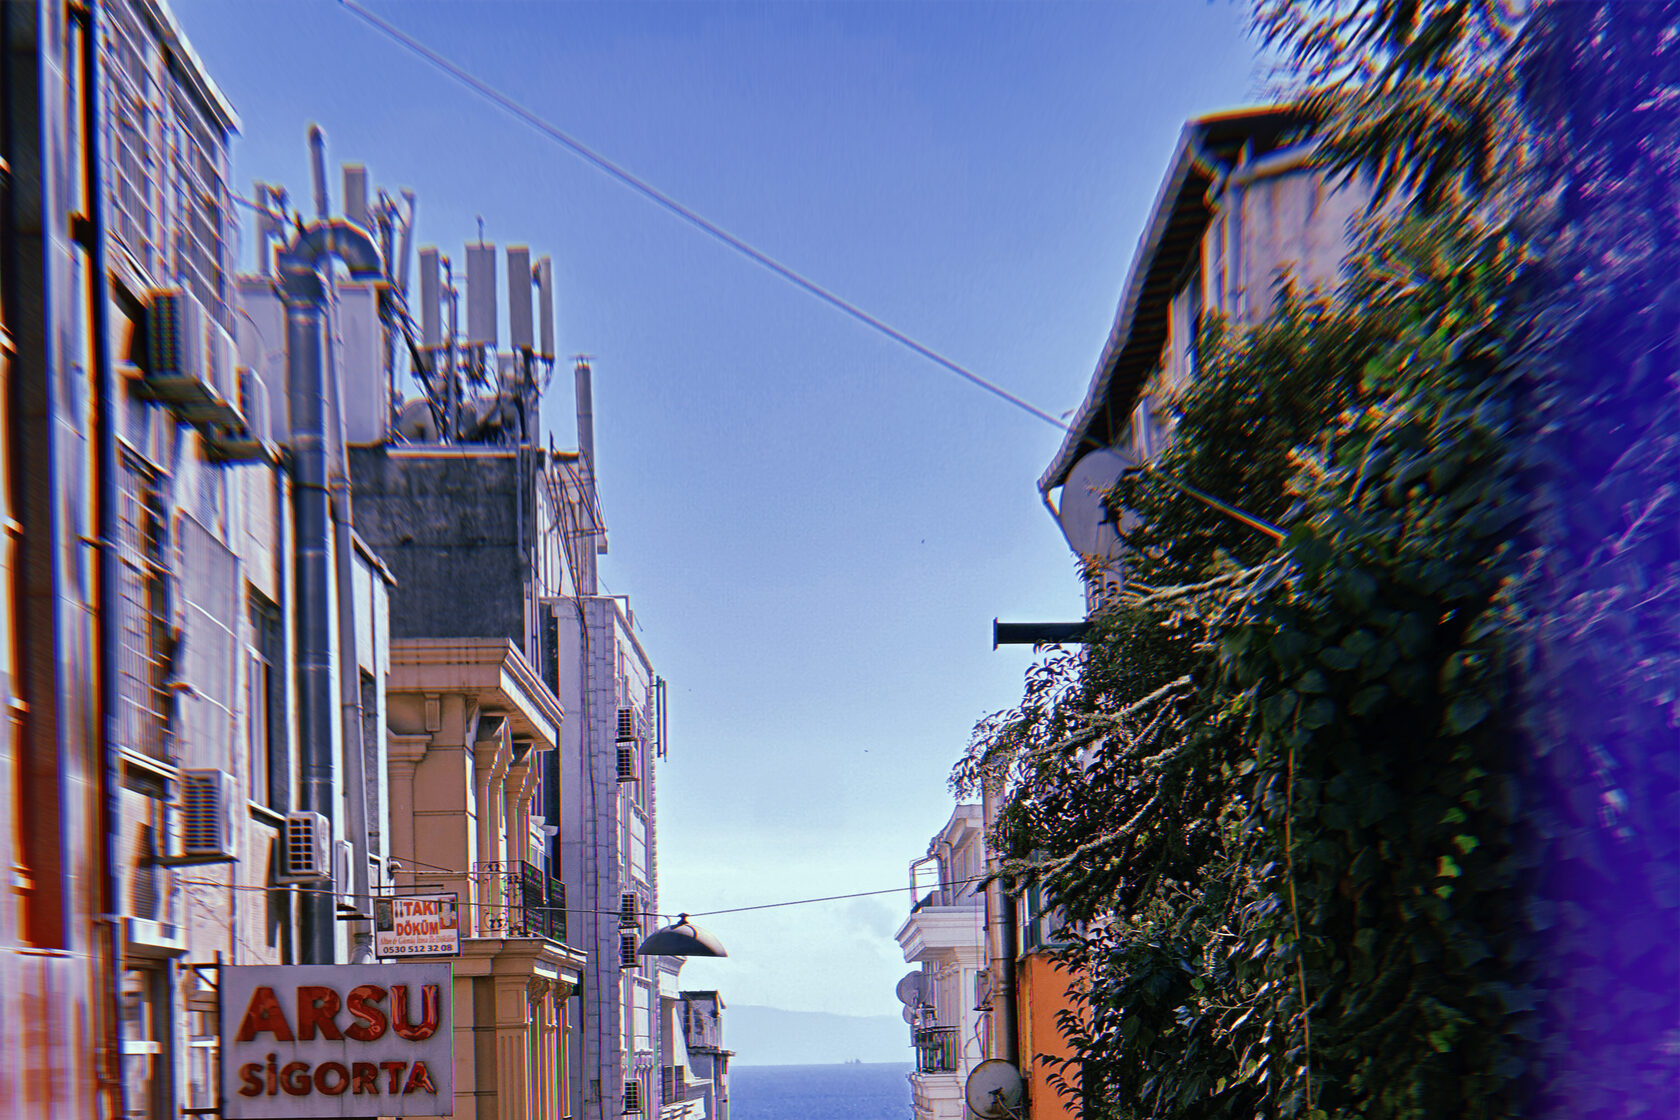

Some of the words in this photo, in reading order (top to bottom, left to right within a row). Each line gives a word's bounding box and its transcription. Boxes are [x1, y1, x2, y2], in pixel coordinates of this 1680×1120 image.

[396, 920, 440, 936] DÖKÜM
[383, 945, 406, 954] 0530
[408, 945, 425, 953] 512
[428, 944, 439, 952] 32
[441, 943, 453, 952] 08
[234, 984, 440, 1042] ARSU
